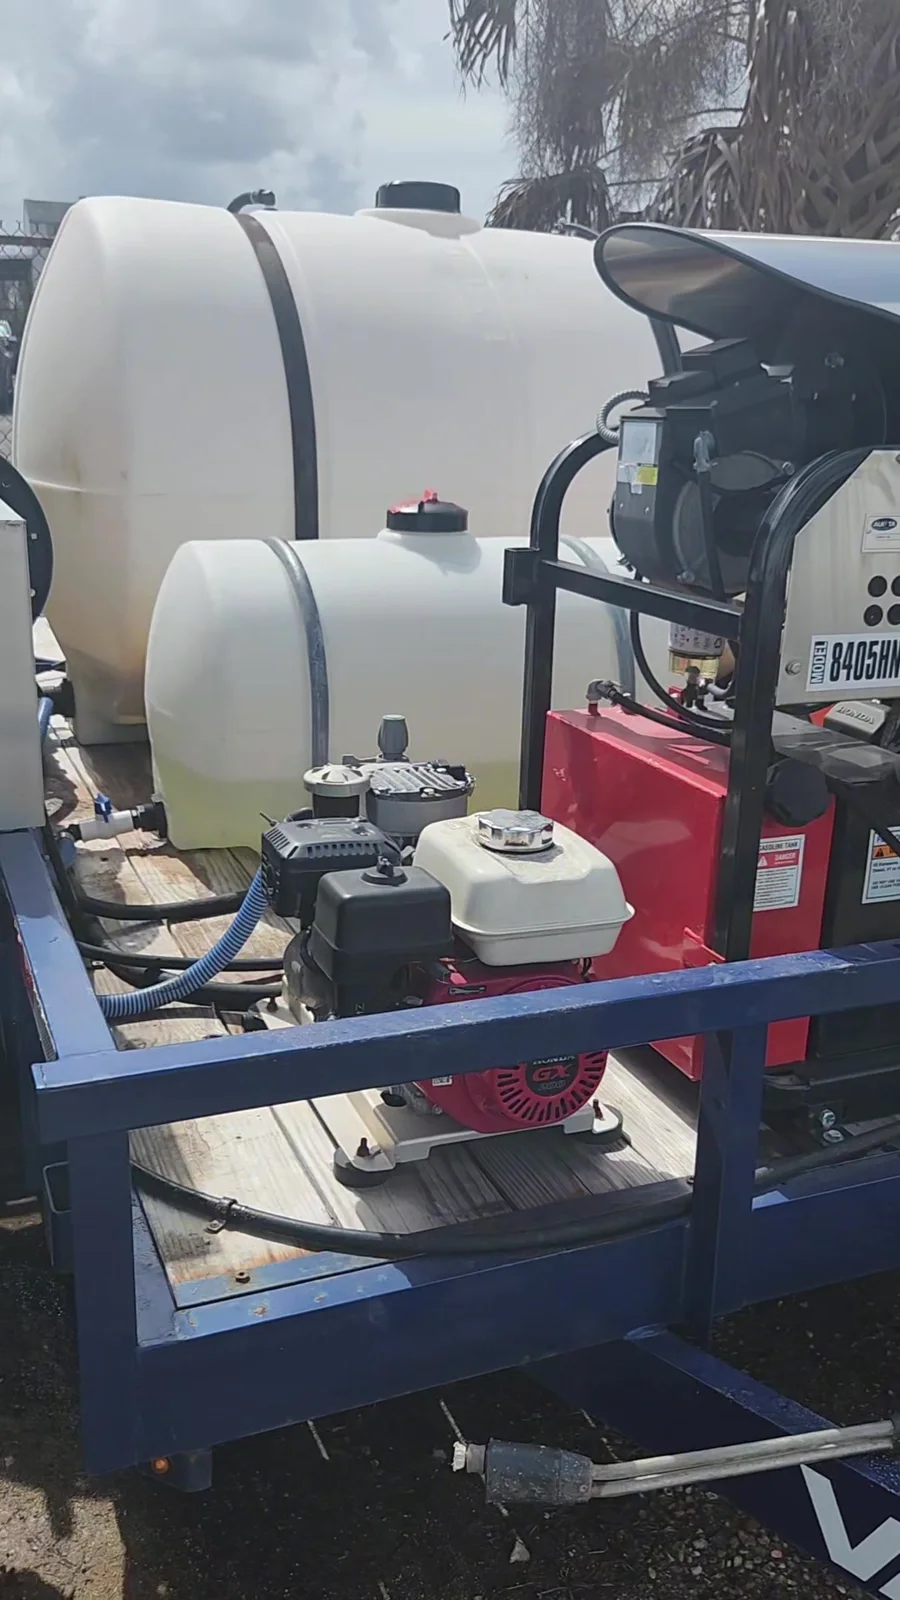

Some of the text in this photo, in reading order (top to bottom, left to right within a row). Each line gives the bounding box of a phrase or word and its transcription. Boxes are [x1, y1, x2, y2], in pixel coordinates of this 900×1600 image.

[811, 641, 827, 684] MODEL
[836, 706, 875, 725] HONDA
[785, 841, 798, 849] TANK
[533, 1064, 570, 1081] GX
